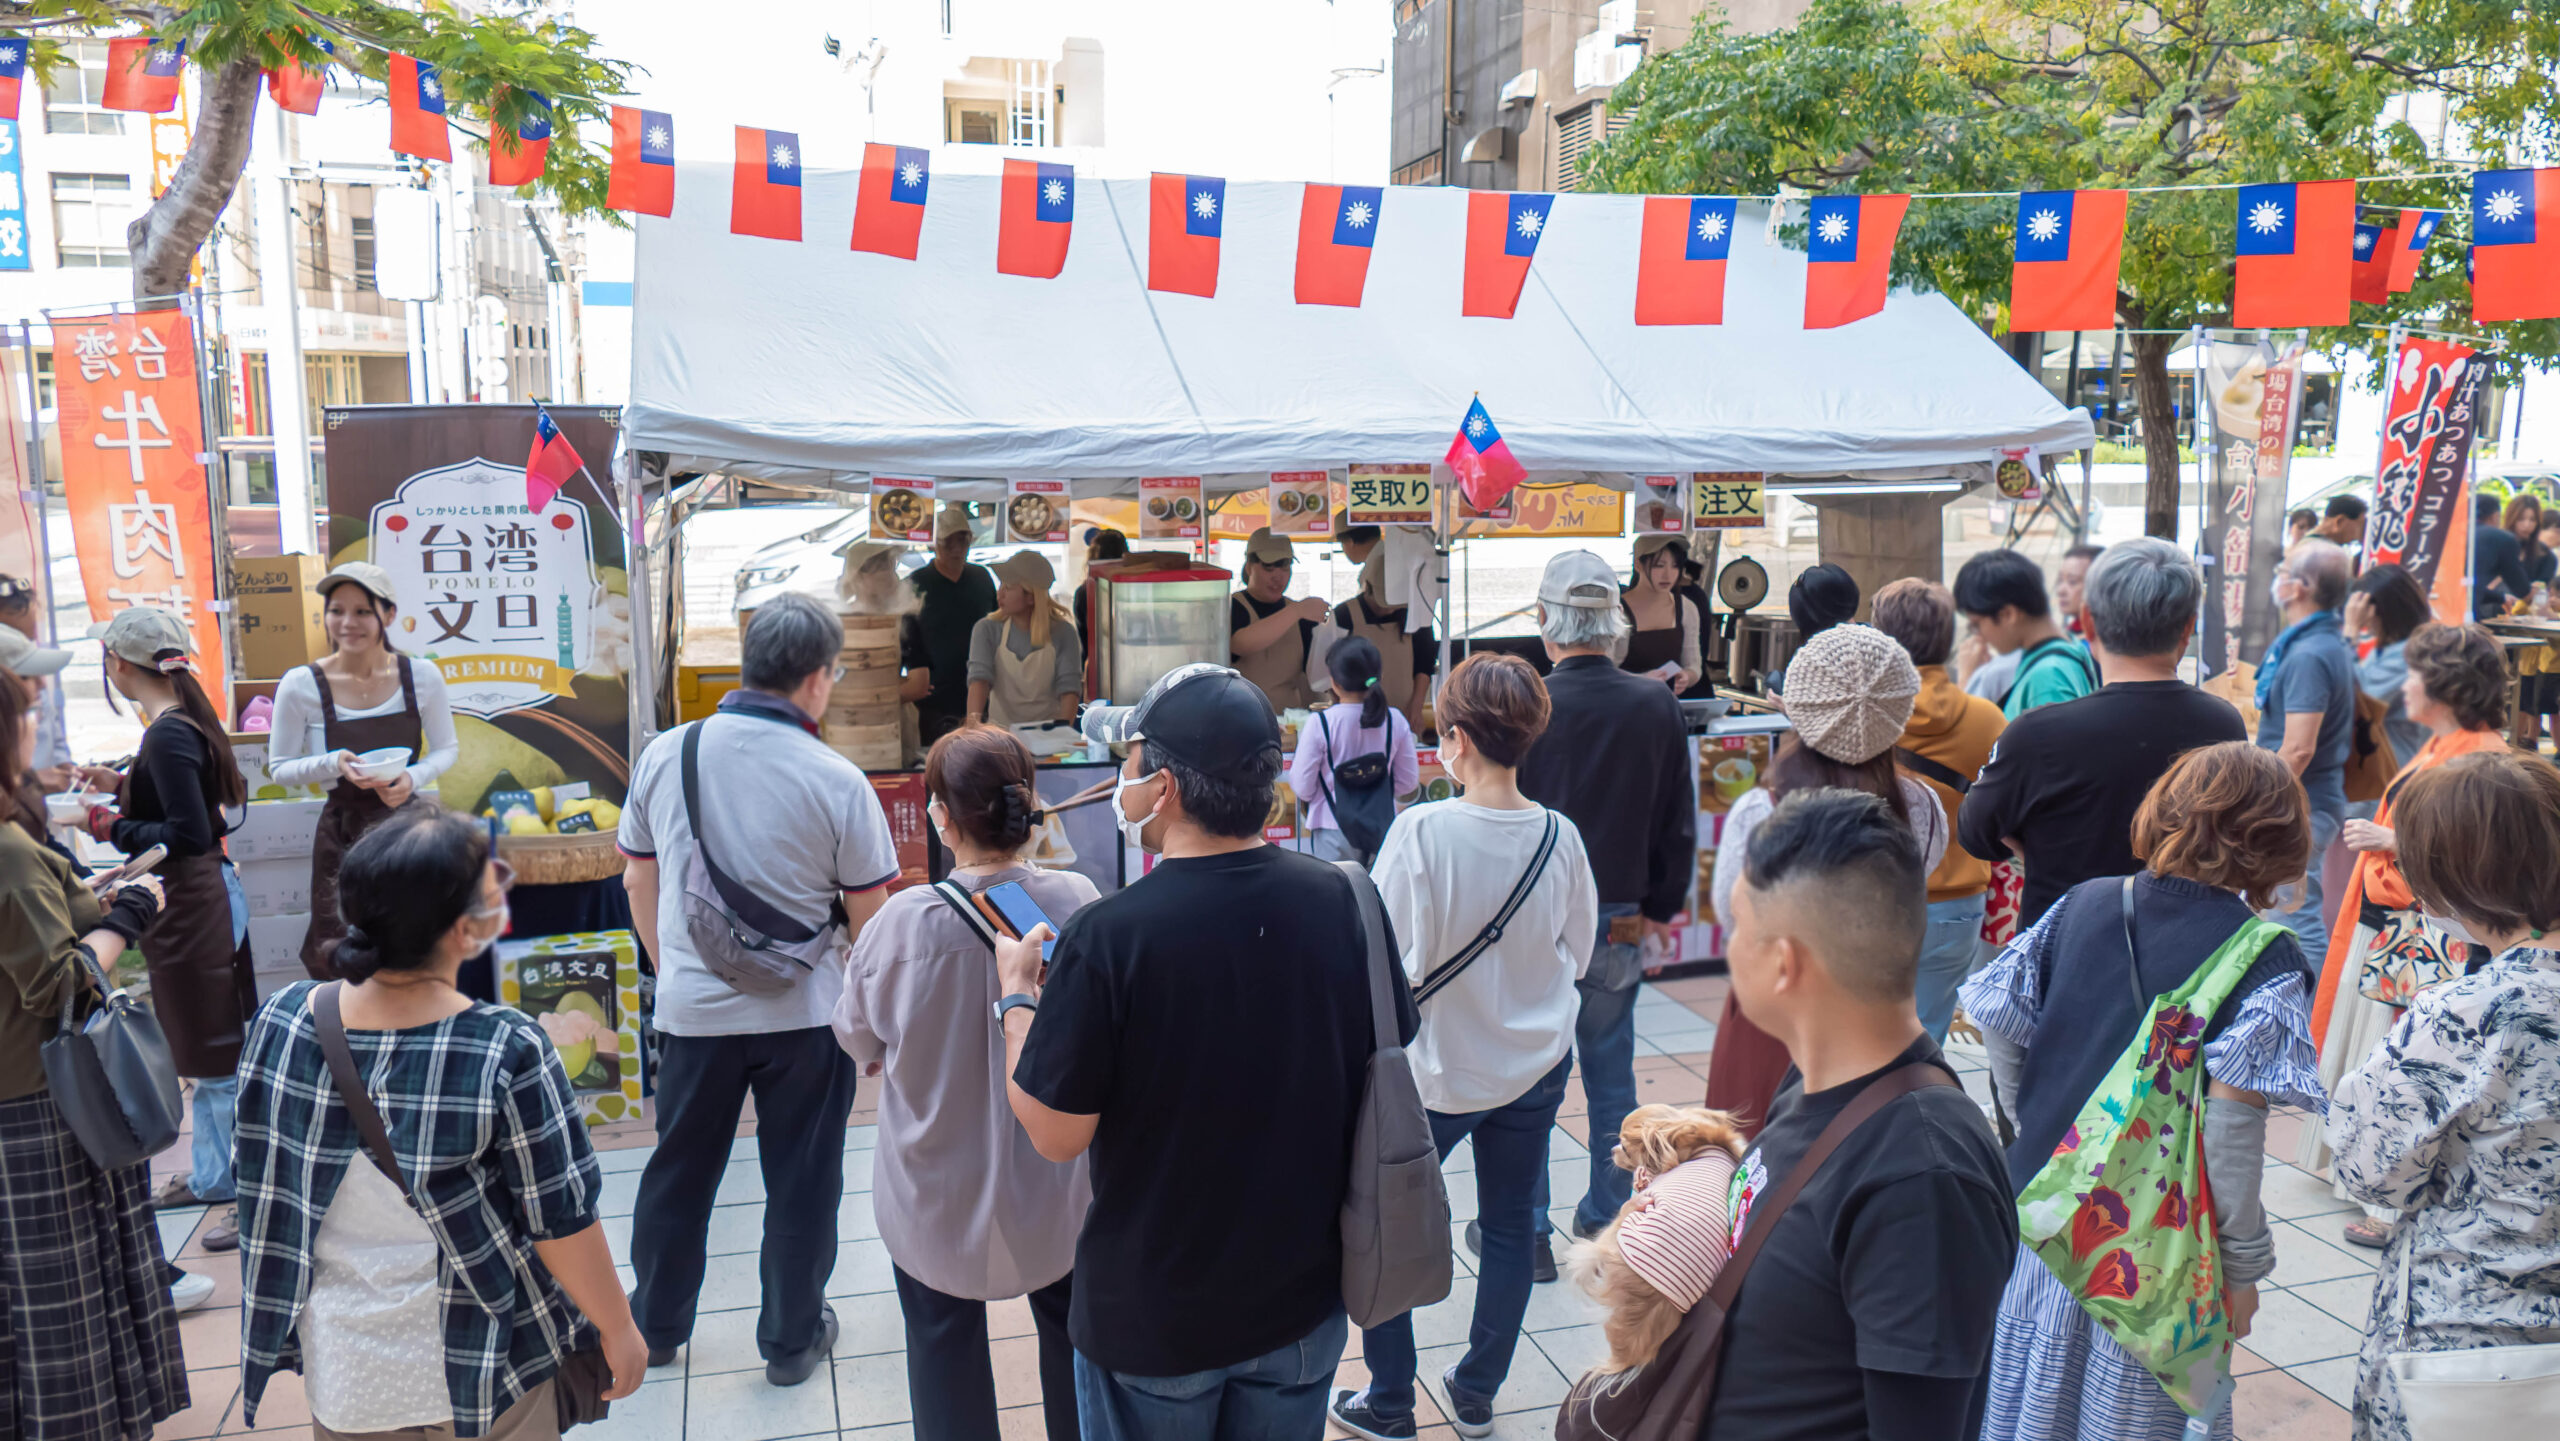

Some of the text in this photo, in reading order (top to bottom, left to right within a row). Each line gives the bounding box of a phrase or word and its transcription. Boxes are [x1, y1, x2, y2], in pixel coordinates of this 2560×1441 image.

[2370, 363, 2446, 566] 小籠
[2407, 362, 2487, 584] 肉汁あつあつ、コラーゲ
[1351, 479, 1430, 507] 受取り
[1700, 483, 1758, 516] 注文
[420, 521, 538, 574] 台湾
[428, 576, 535, 590] POMELO
[424, 592, 545, 645] 文旦
[443, 660, 545, 680] REMIUM
[522, 959, 610, 985] 台湾文旦
